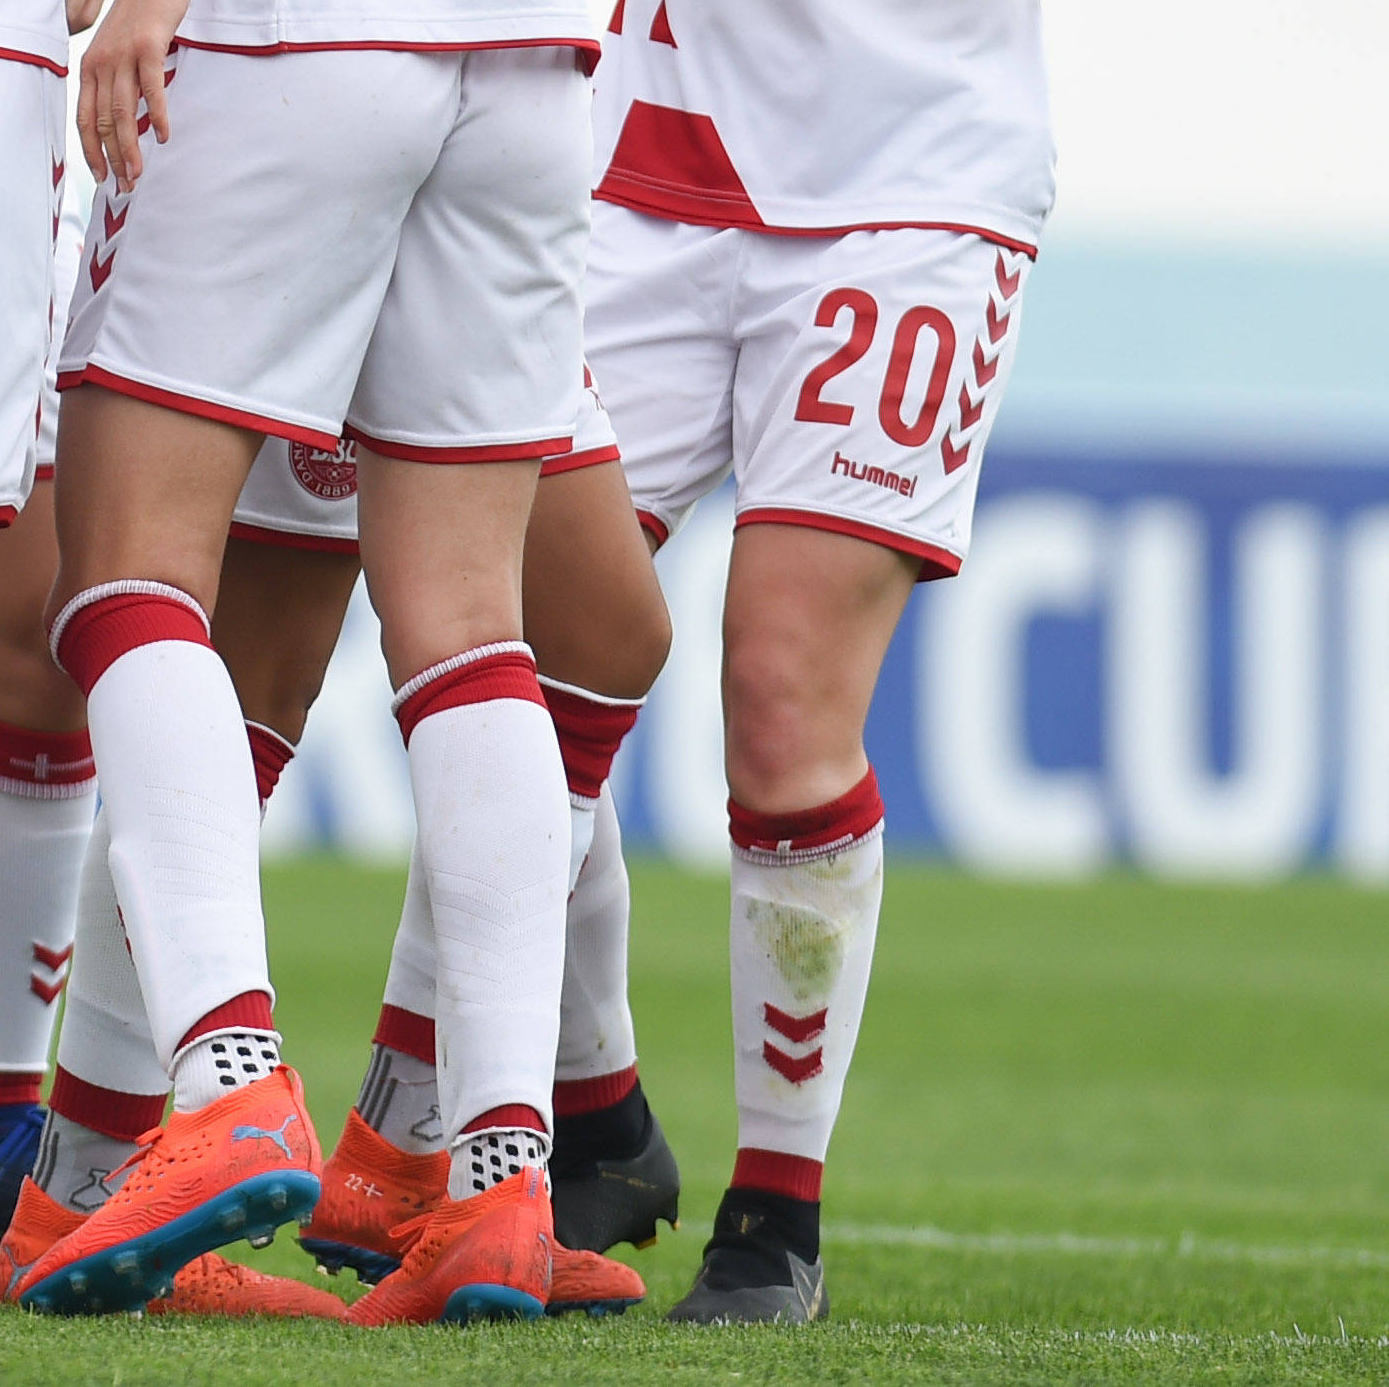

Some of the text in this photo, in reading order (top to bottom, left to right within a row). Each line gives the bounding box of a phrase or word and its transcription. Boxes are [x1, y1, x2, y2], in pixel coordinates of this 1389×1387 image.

[793, 286, 957, 448] 20
[830, 450, 918, 499] hummel
[918, 491, 1389, 881] CU
